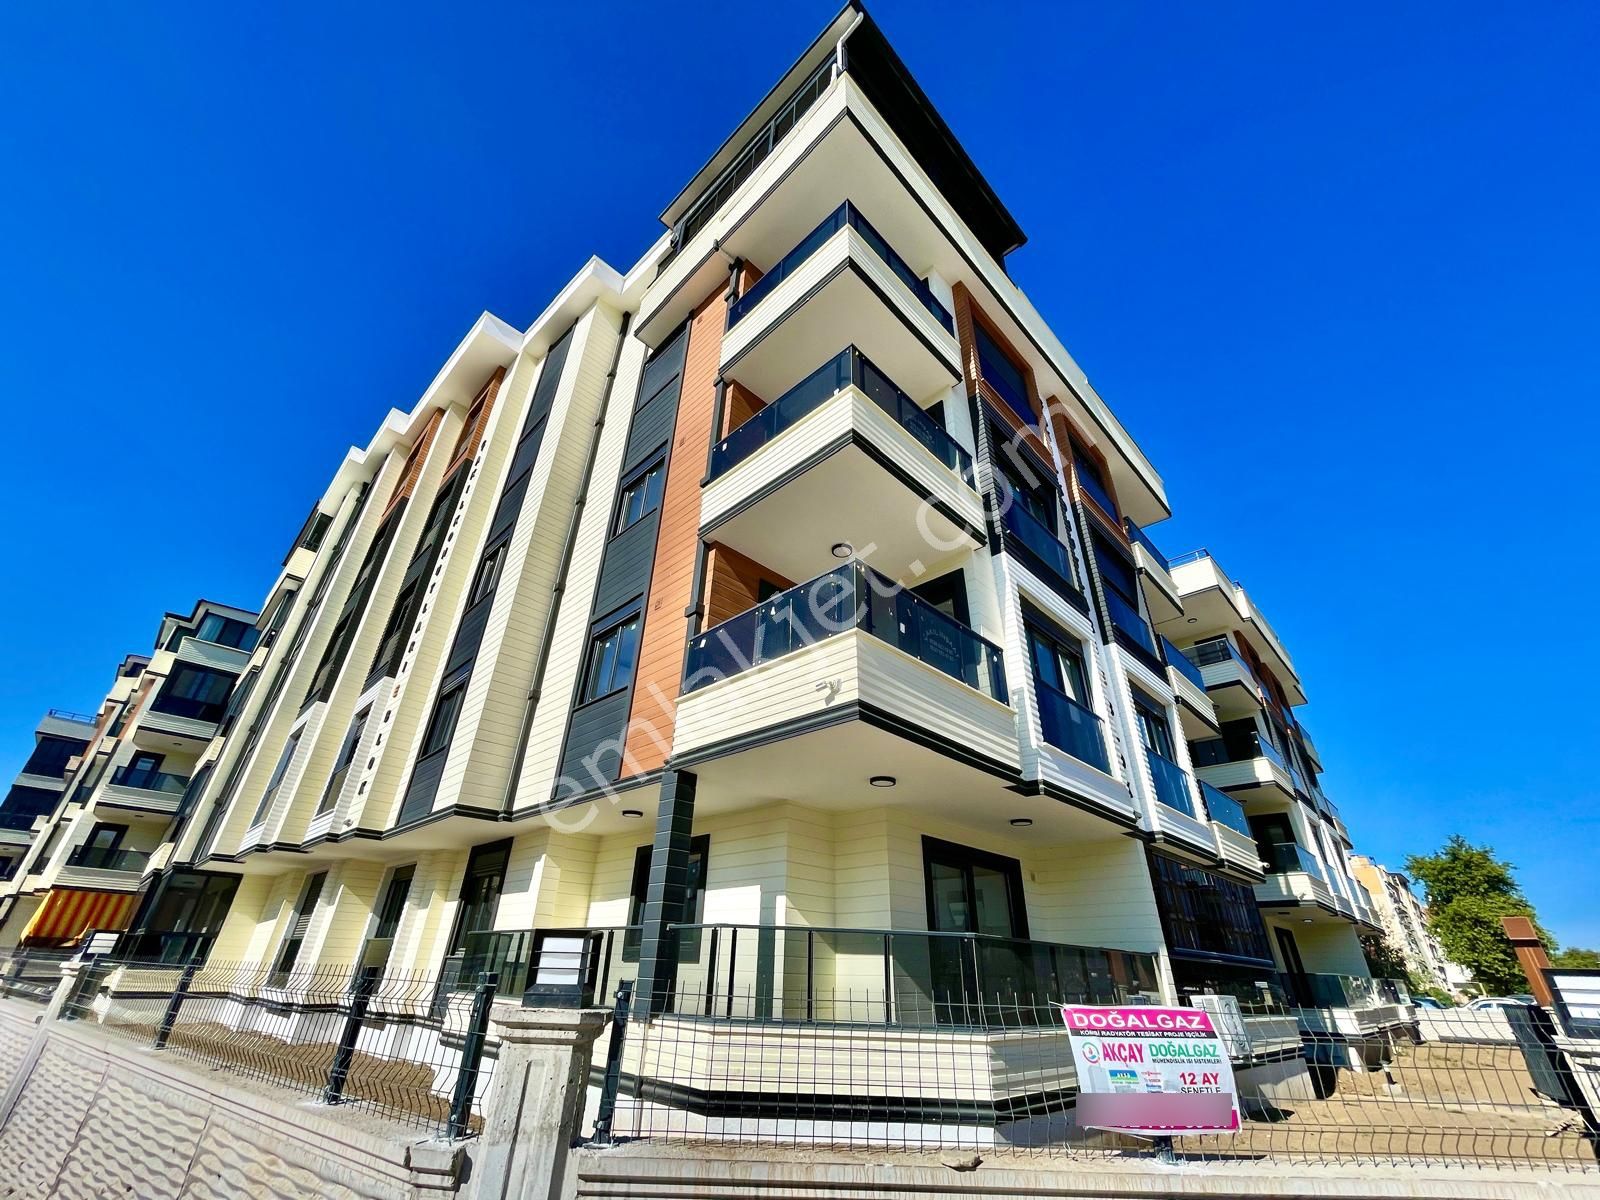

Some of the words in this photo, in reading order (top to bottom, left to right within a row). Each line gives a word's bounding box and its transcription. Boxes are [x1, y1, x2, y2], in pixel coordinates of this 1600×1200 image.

[1073, 1011, 1206, 1028] DOĞALGAZ
[1101, 1042, 1145, 1063] AKÇAY
[1149, 1041, 1220, 1057] DOĞALGAZ
[1179, 1072, 1198, 1085] 12
[1202, 1073, 1219, 1085] AY
